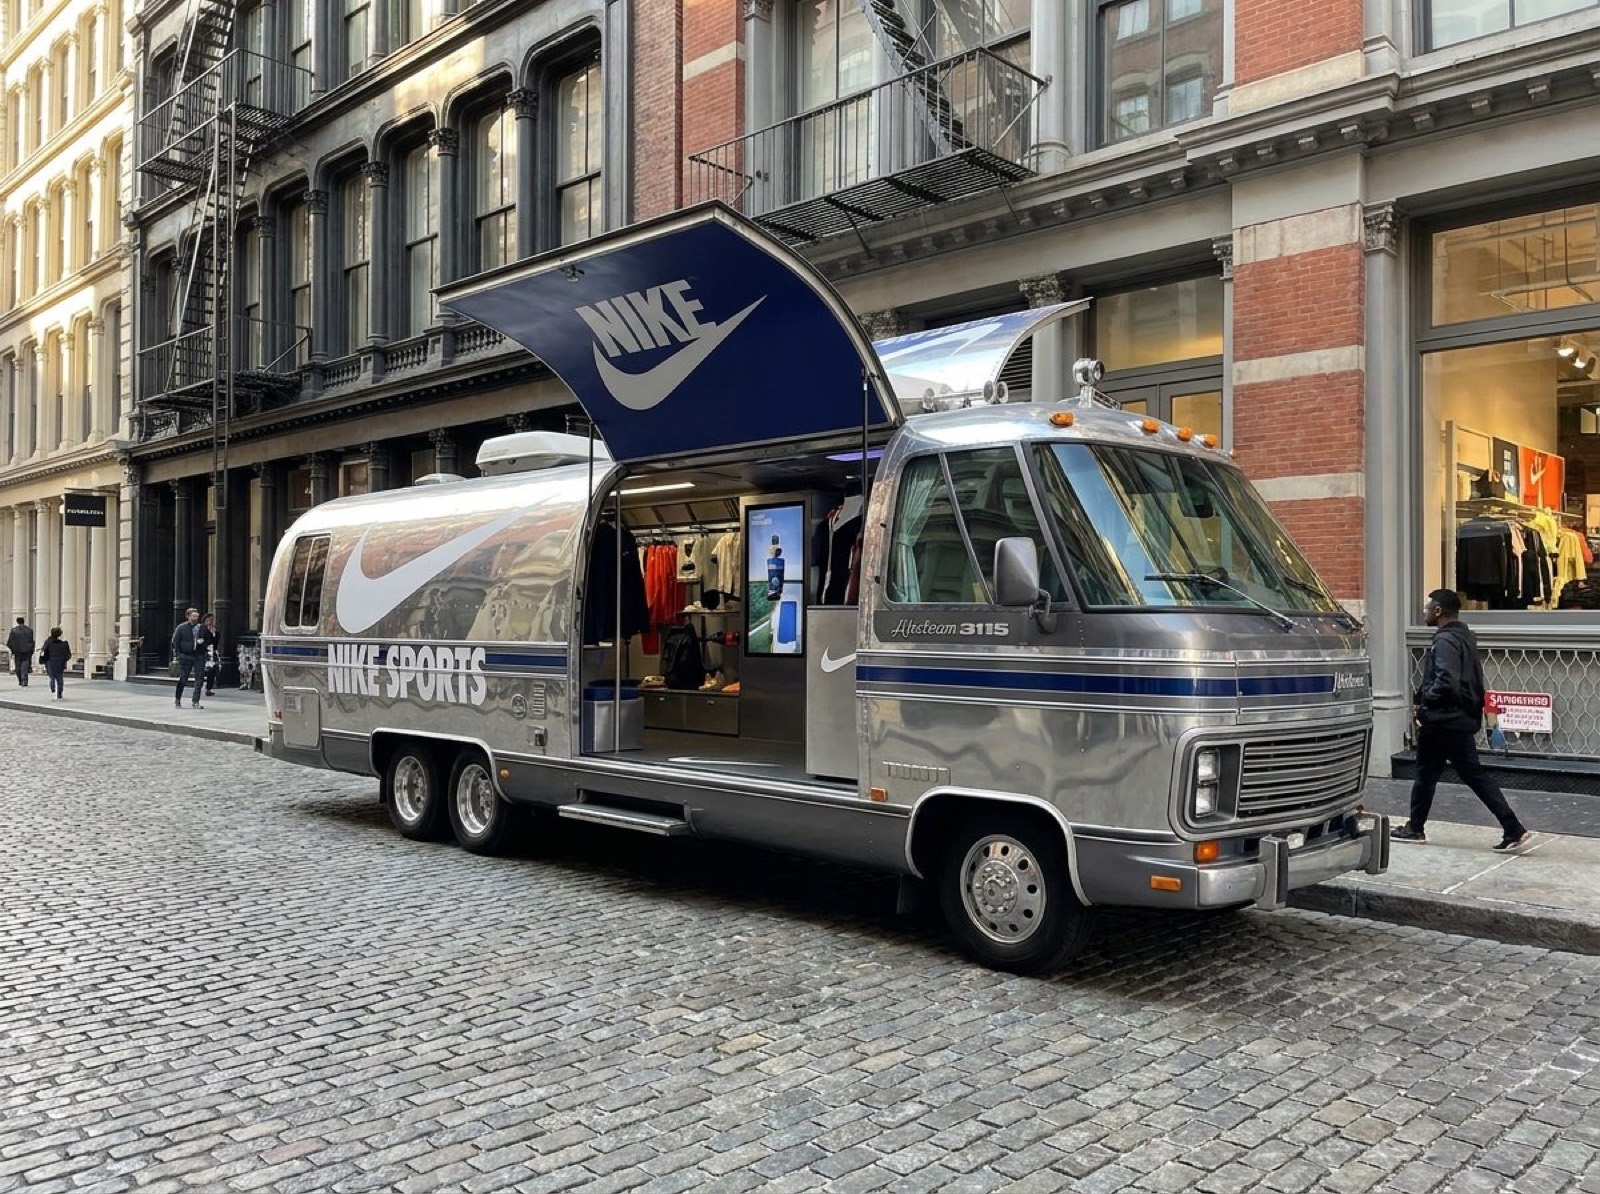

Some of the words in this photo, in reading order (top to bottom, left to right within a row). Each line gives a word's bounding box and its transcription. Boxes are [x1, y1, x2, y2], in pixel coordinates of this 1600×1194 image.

[574, 279, 717, 358] NIKE
[959, 623, 1009, 636] 3115
[327, 643, 380, 697] NIKE
[386, 645, 486, 706] SPORTS
